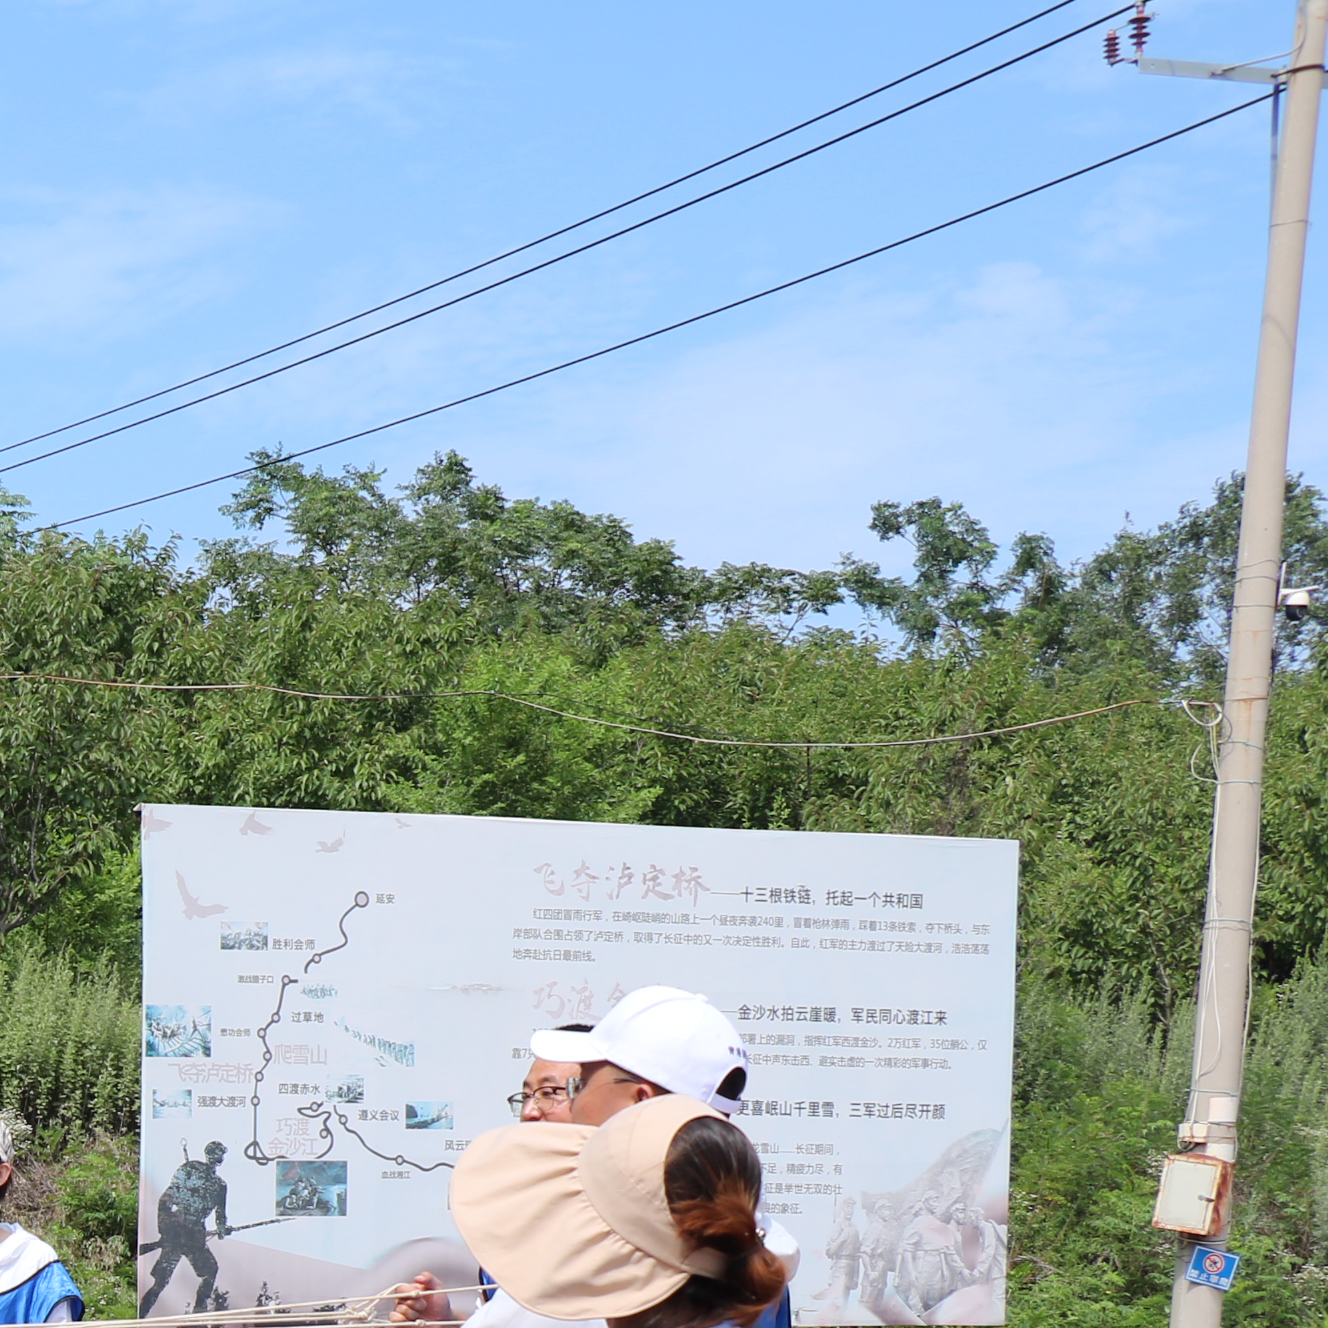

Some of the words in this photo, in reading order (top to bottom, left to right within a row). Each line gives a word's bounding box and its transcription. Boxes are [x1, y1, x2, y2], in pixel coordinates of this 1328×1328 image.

[533, 859, 711, 907] 飞夺泸定桥
[375, 893, 395, 904] 延安
[272, 938, 316, 951] 胜利会师
[512, 947, 596, 963] 地奔赴抗日最前线。
[291, 1011, 325, 1024] 过草地
[273, 1044, 328, 1065] 爬雪山
[168, 1062, 254, 1084] 飞夺泸定桥
[278, 1083, 321, 1095] 四渡赤水
[197, 1095, 247, 1108] 强渡大渡河
[357, 1109, 400, 1121] 遵义会议
[381, 1170, 411, 1179] 血战湘江
